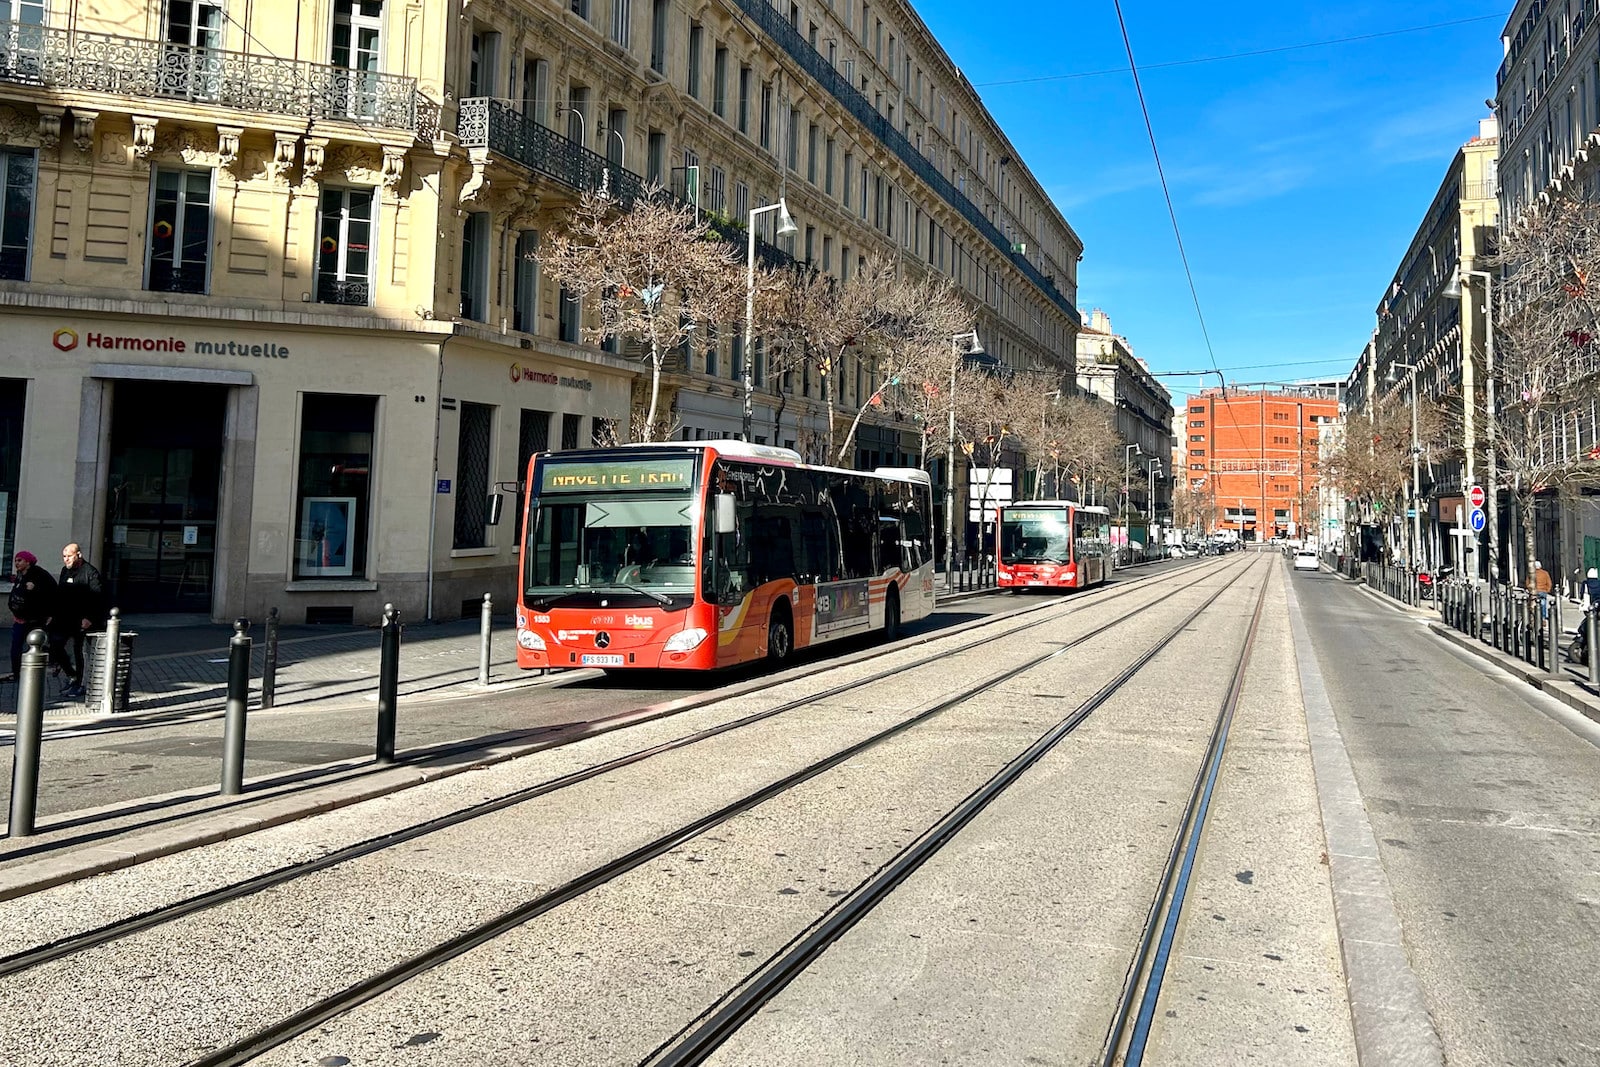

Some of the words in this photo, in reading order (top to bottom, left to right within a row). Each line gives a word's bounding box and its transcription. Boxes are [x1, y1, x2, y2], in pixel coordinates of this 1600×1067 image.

[86, 332, 186, 352] Harmonie
[194, 340, 290, 358] mutuelle
[523, 367, 558, 385] Harmonie
[625, 614, 653, 625] lebus
